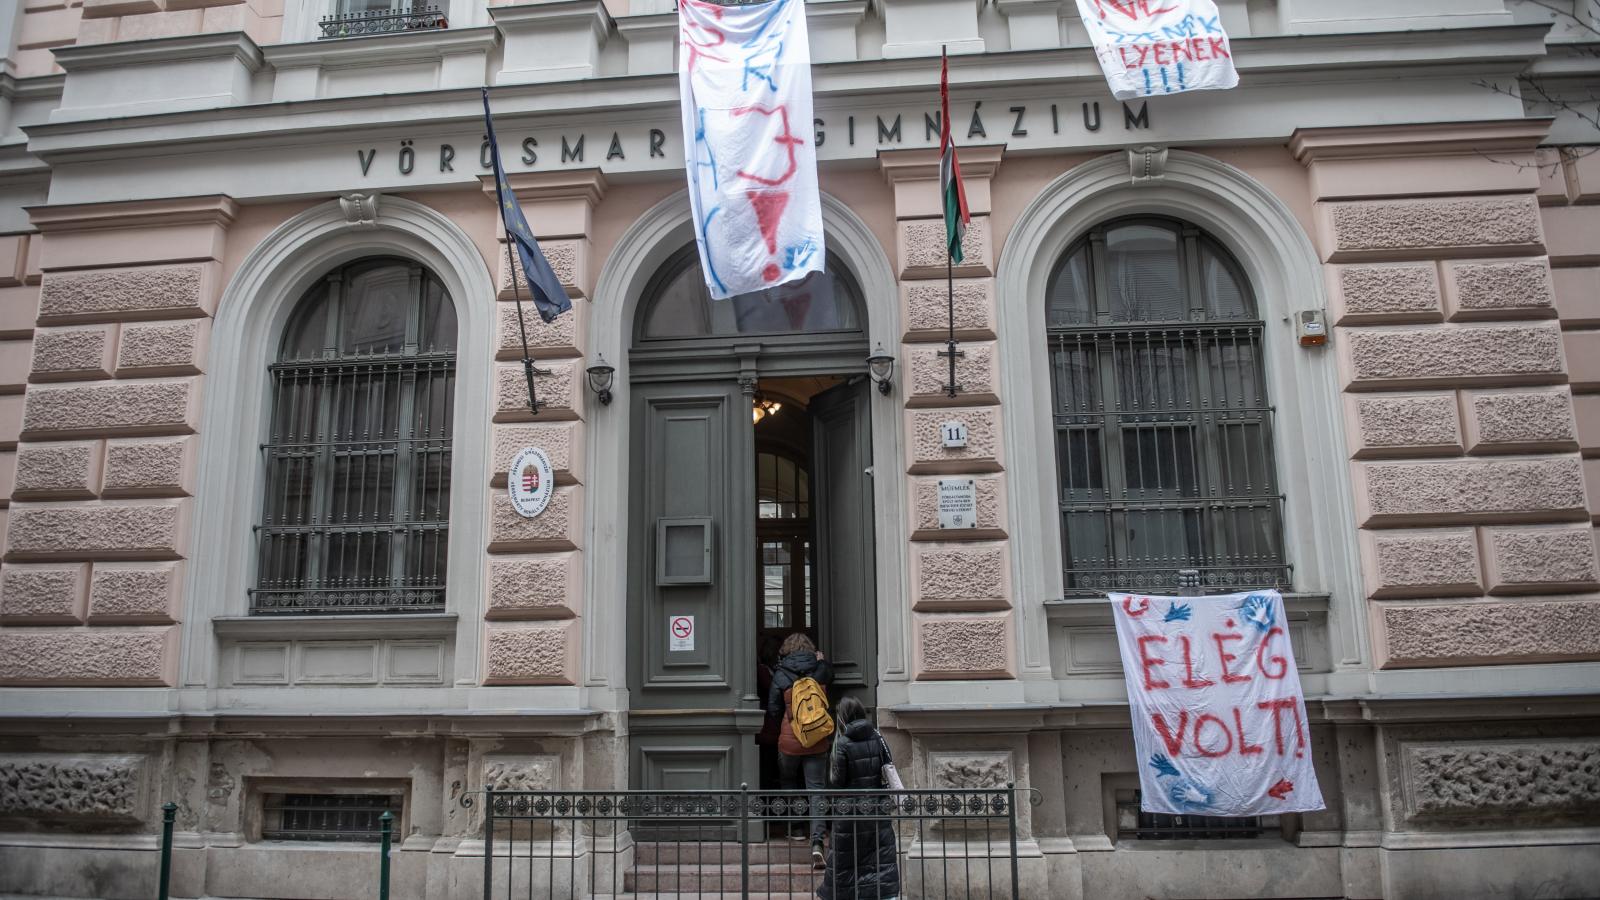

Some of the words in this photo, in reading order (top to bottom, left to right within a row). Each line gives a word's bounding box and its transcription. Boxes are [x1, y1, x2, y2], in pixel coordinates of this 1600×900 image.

[812, 100, 1150, 147] GIMNÁZIUM
[1137, 618, 1289, 691] ELÉG
[1152, 696, 1306, 759] VOLT!
